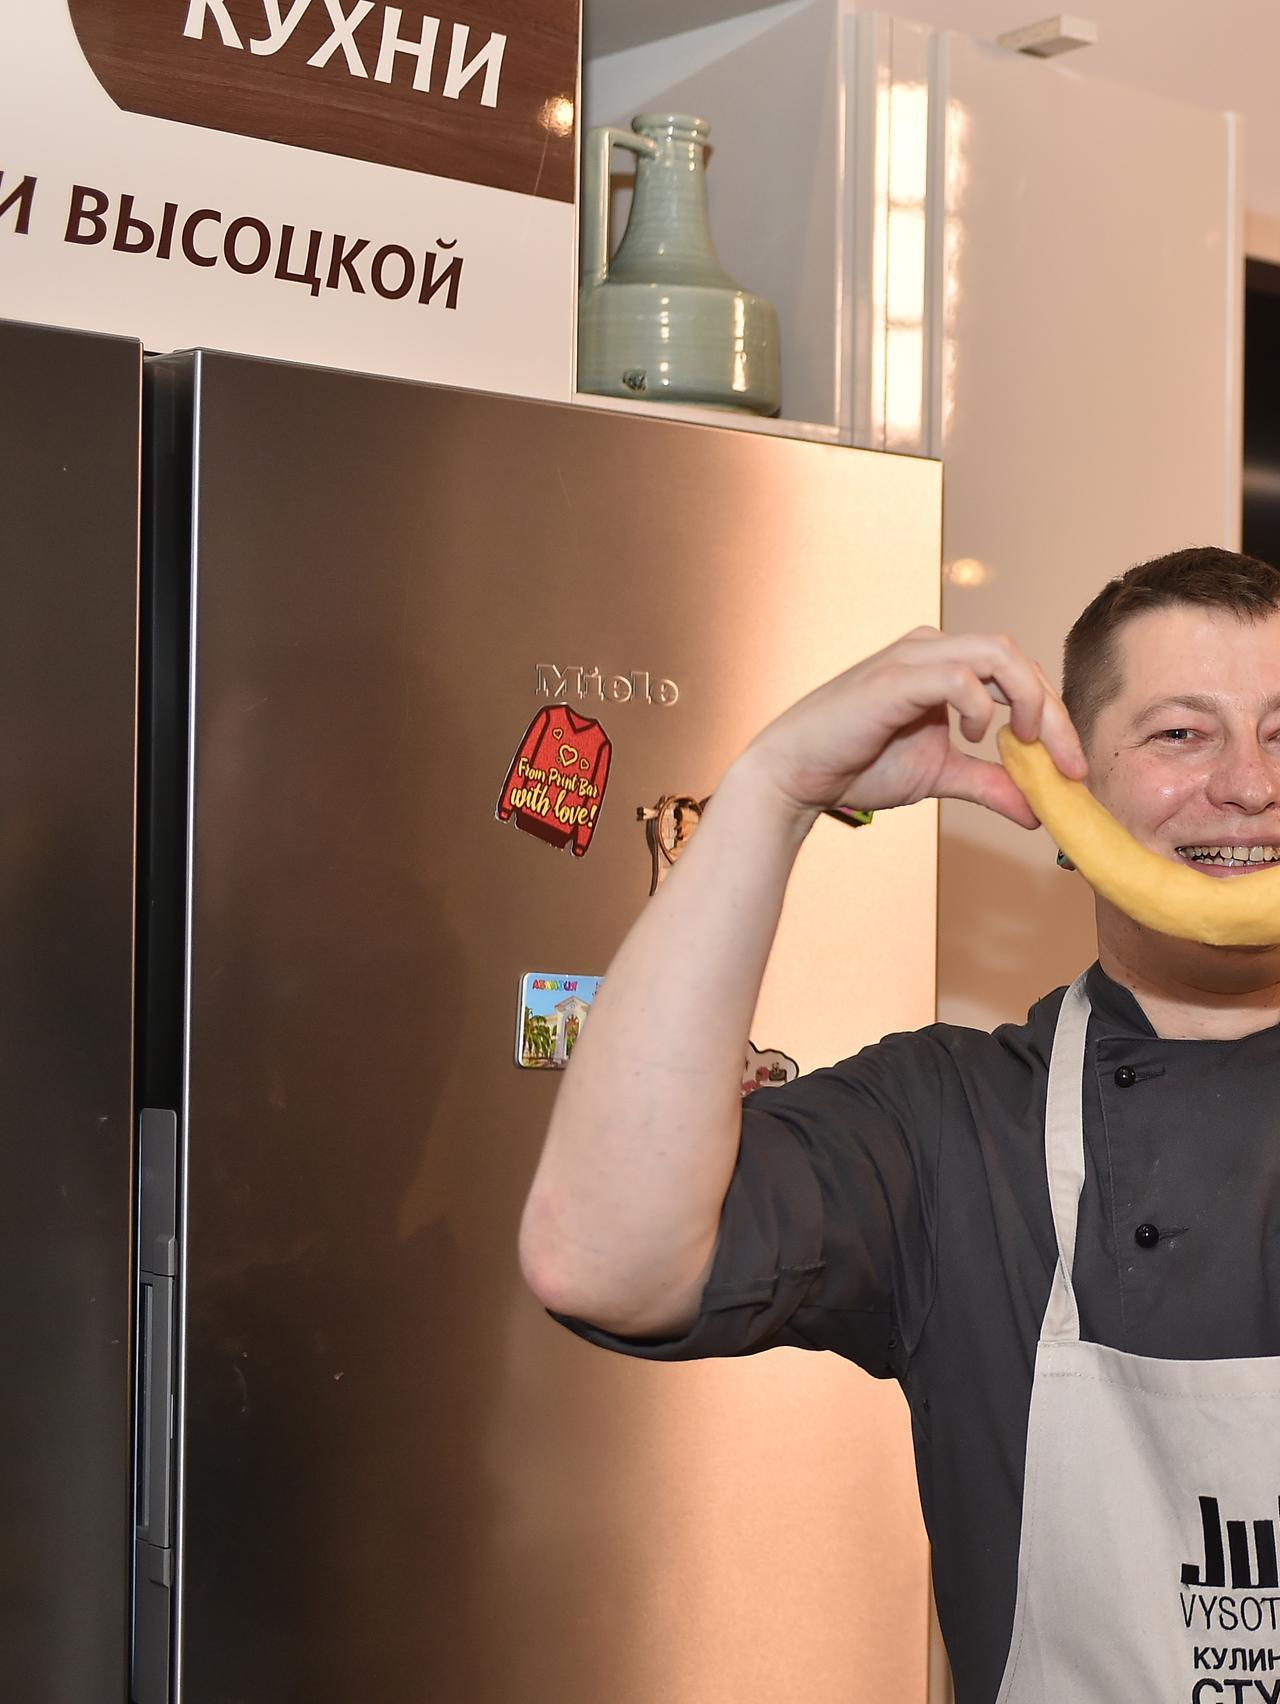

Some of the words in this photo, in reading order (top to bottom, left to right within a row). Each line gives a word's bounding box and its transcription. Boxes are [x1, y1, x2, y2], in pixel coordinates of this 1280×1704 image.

[64, 184, 464, 310] ВЫСОЦКОЙ
[535, 664, 679, 706] Miele
[518, 757, 546, 782] From
[548, 767, 578, 791] Print
[579, 778, 599, 798] Bar
[510, 782, 551, 817] with
[554, 789, 598, 828] love!
